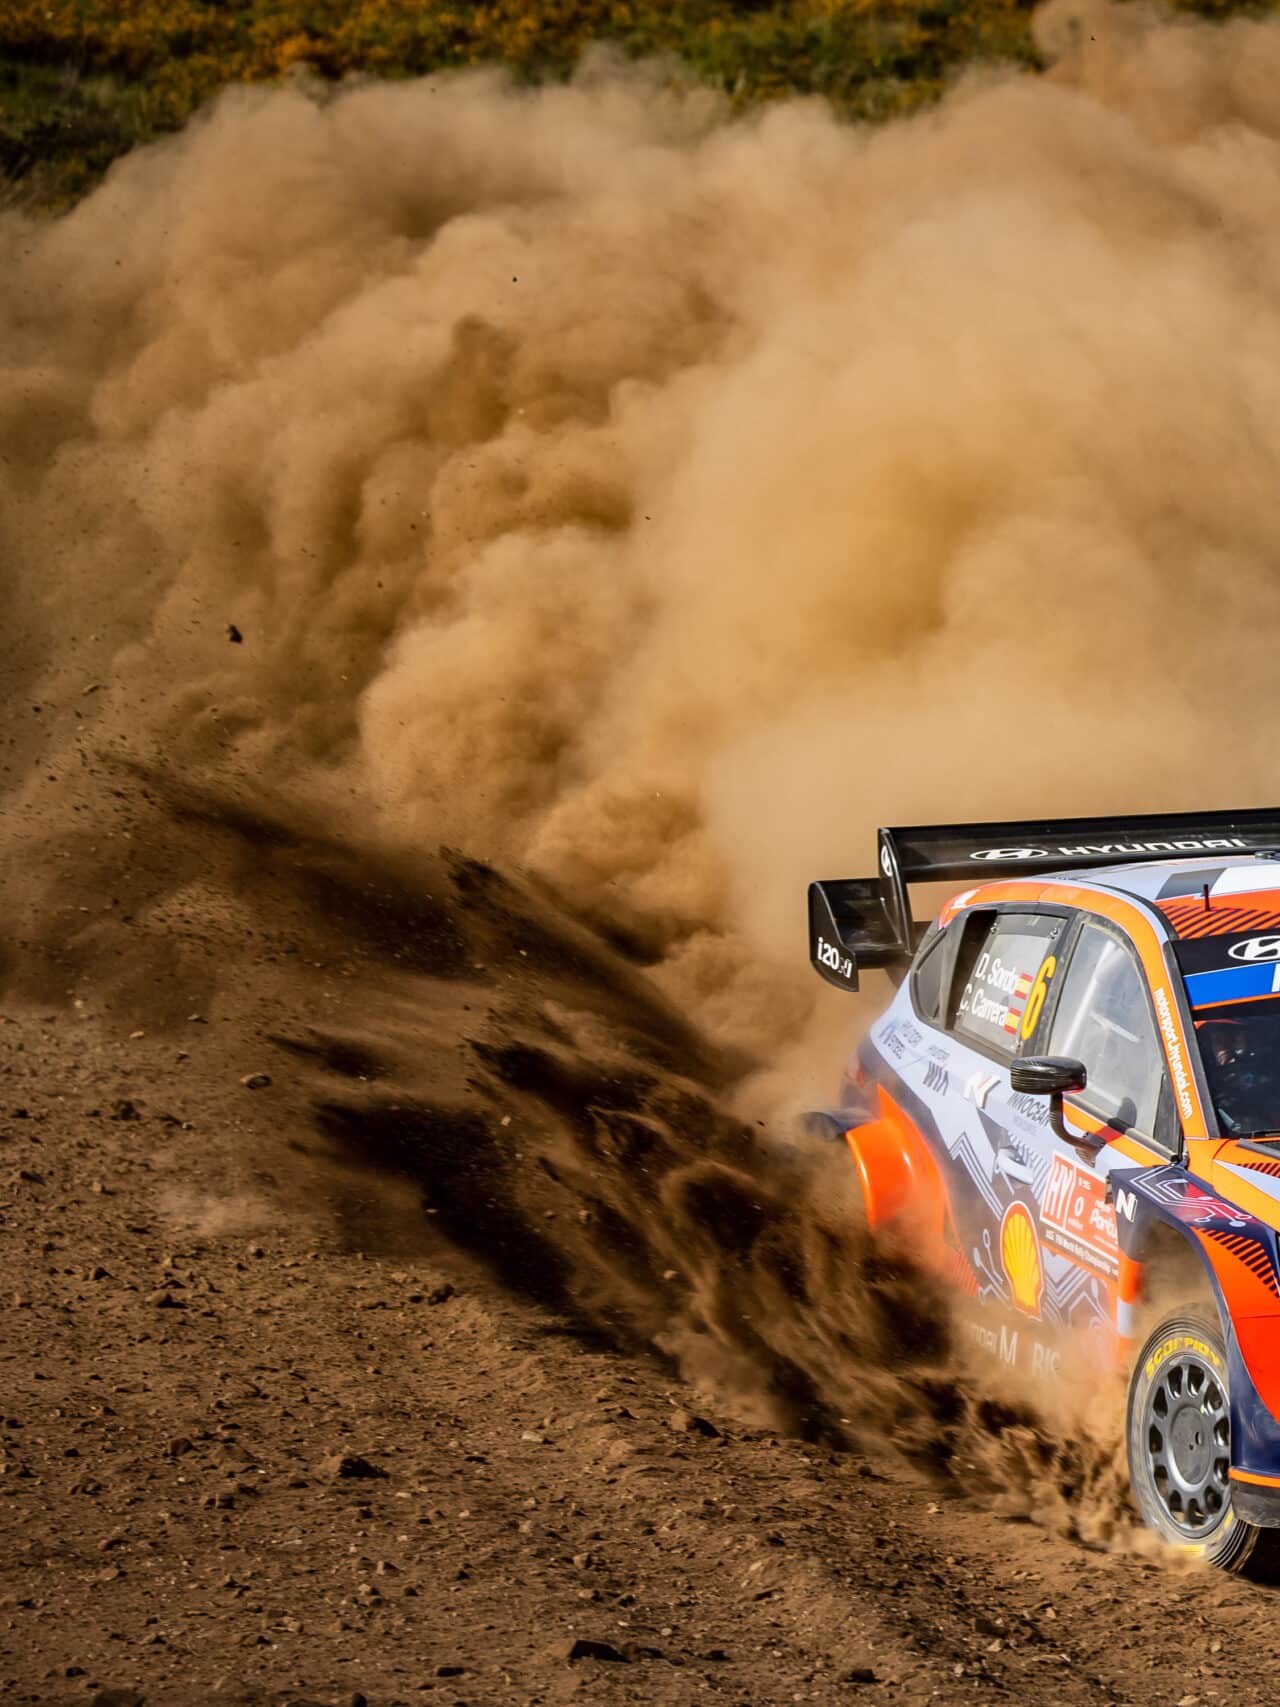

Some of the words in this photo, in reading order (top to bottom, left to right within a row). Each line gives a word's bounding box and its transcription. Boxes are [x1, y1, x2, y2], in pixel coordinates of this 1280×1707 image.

[1058, 839, 1247, 856] HYUNDAI
[975, 953, 990, 981] D.
[988, 958, 1018, 996] Sordo
[972, 988, 1010, 1027] Carrera
[1021, 955, 1057, 1041] 6
[1007, 1093, 1050, 1127] INNOCEA
